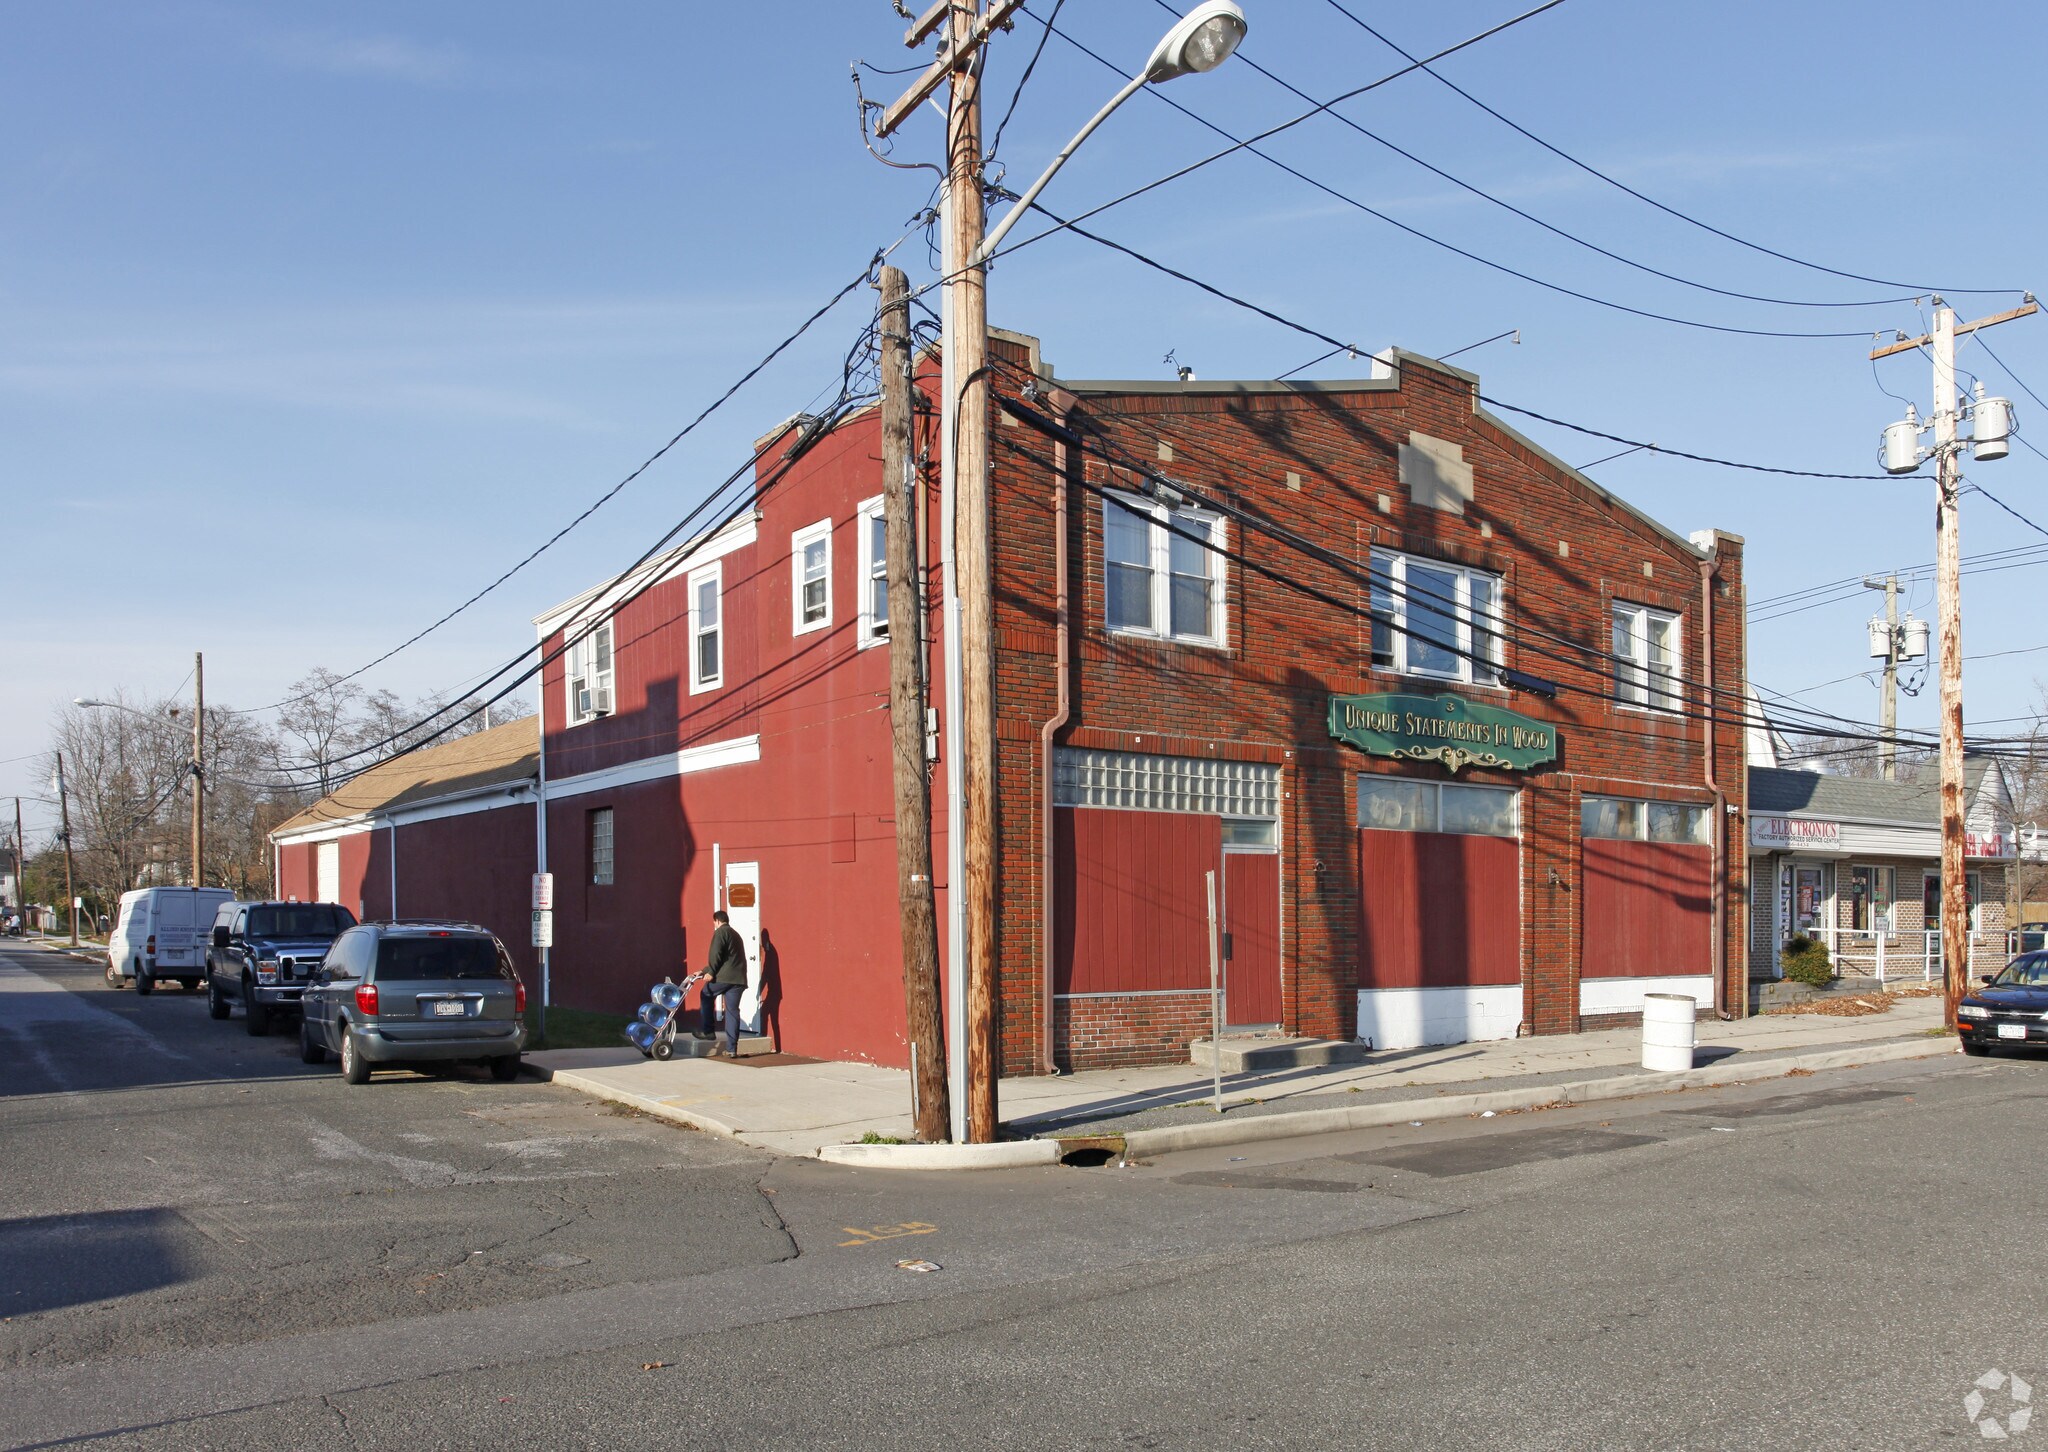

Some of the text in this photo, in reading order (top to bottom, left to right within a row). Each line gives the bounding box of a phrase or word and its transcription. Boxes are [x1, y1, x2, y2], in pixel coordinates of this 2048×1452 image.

[1446, 702, 1455, 712] 3
[1345, 704, 1399, 732] UNIQUE
[1406, 712, 1490, 744] STATEMENTS
[1512, 726, 1548, 750] WOOD
[1771, 819, 1836, 837] ELECTRONICS
